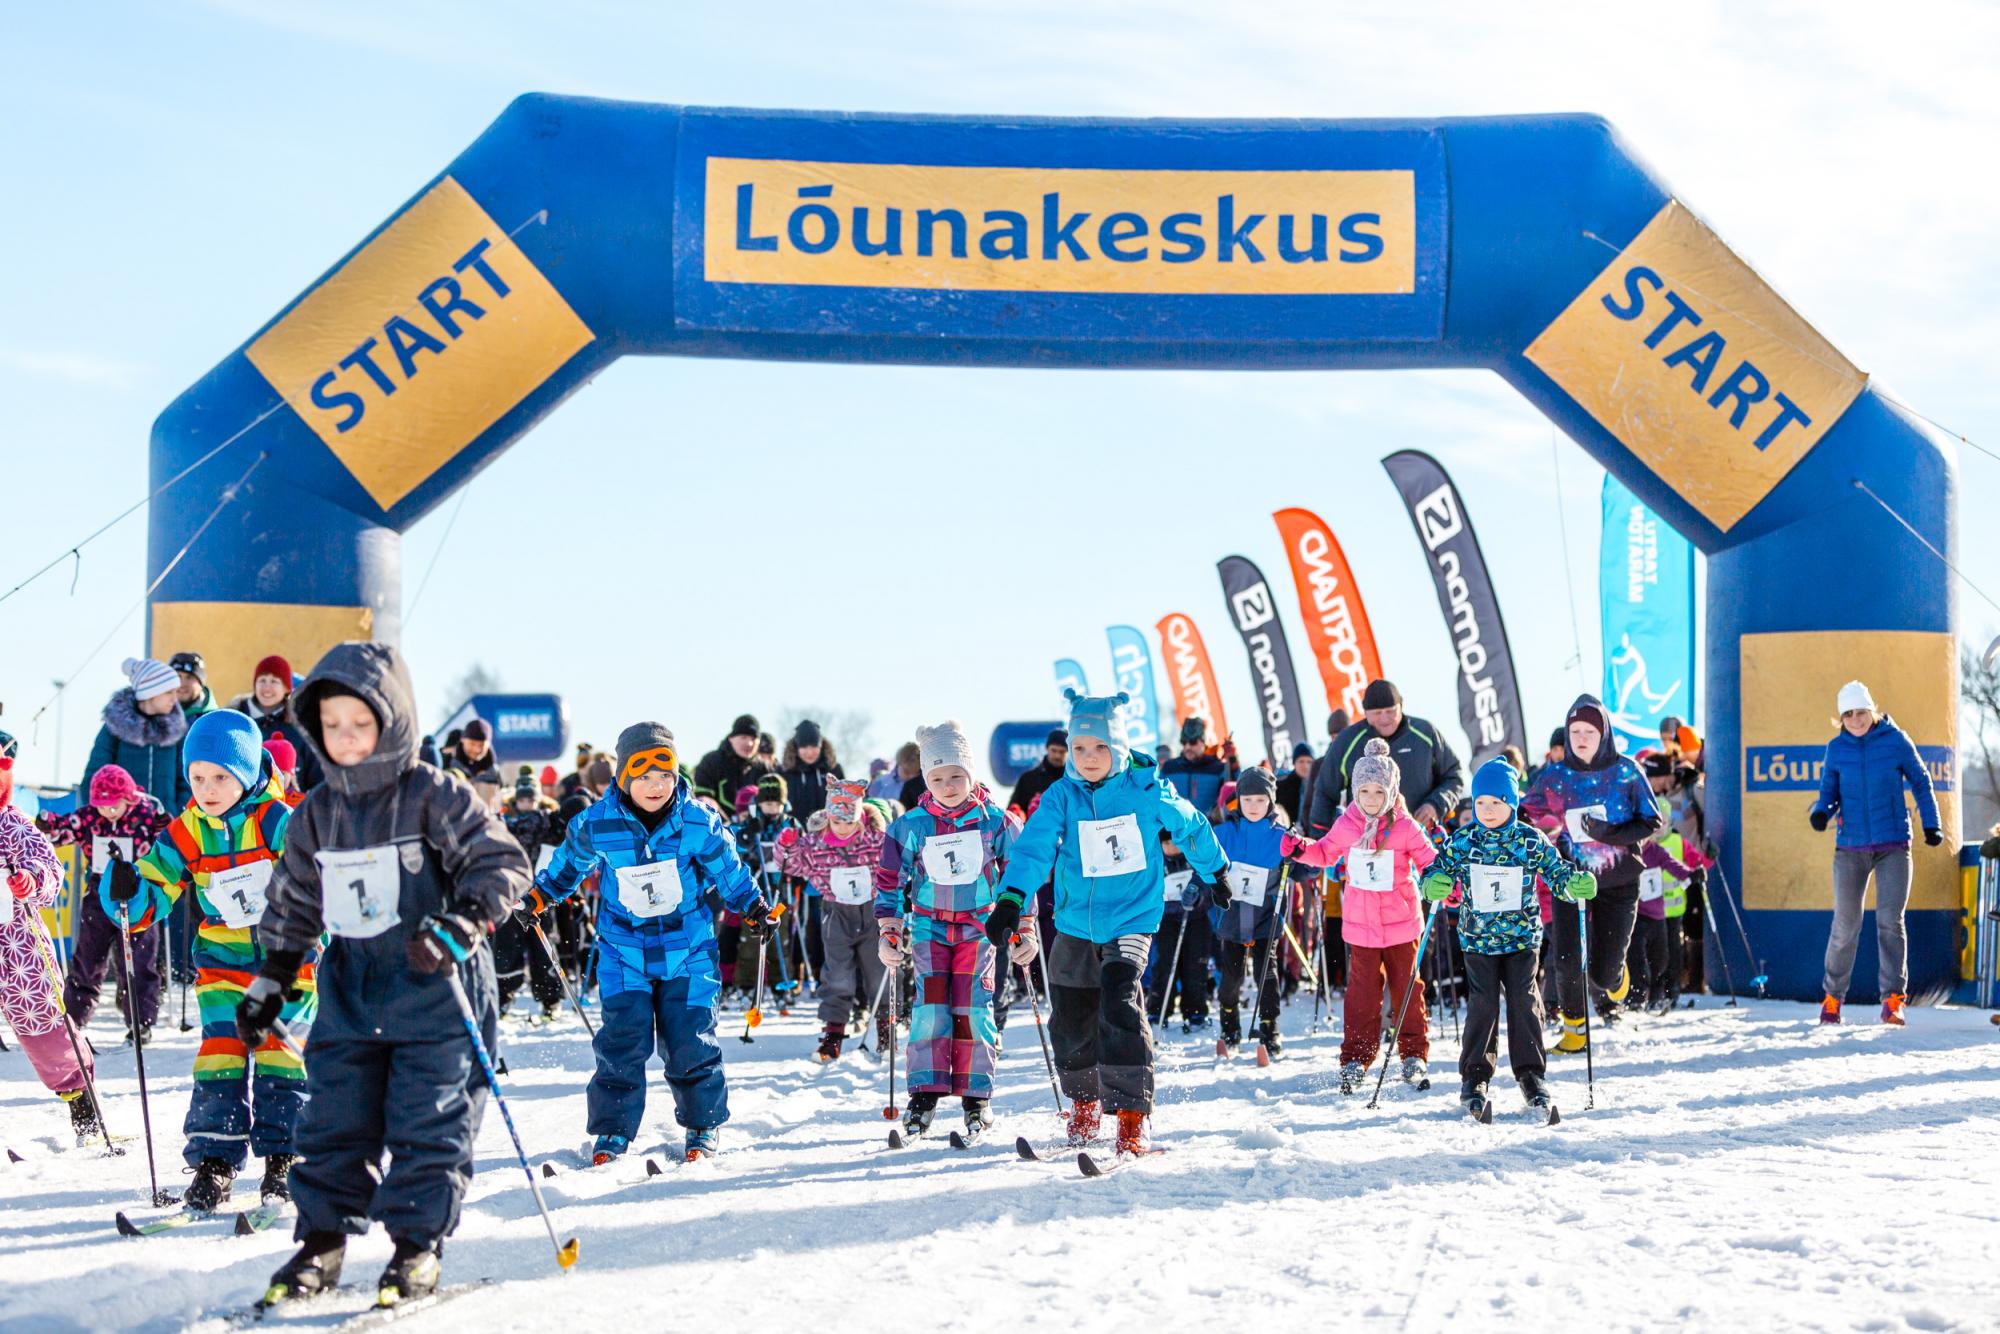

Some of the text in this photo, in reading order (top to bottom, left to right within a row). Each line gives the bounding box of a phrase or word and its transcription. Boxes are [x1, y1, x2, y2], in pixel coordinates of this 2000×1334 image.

[309, 236, 512, 434] START
[1600, 265, 1813, 452] START
[498, 712, 551, 733] START
[1105, 834, 1121, 862] 1
[944, 850, 960, 875] 1
[231, 888, 253, 915] 1
[348, 878, 371, 918] 1
[641, 882, 656, 905] 1
[848, 879, 861, 898] 1
